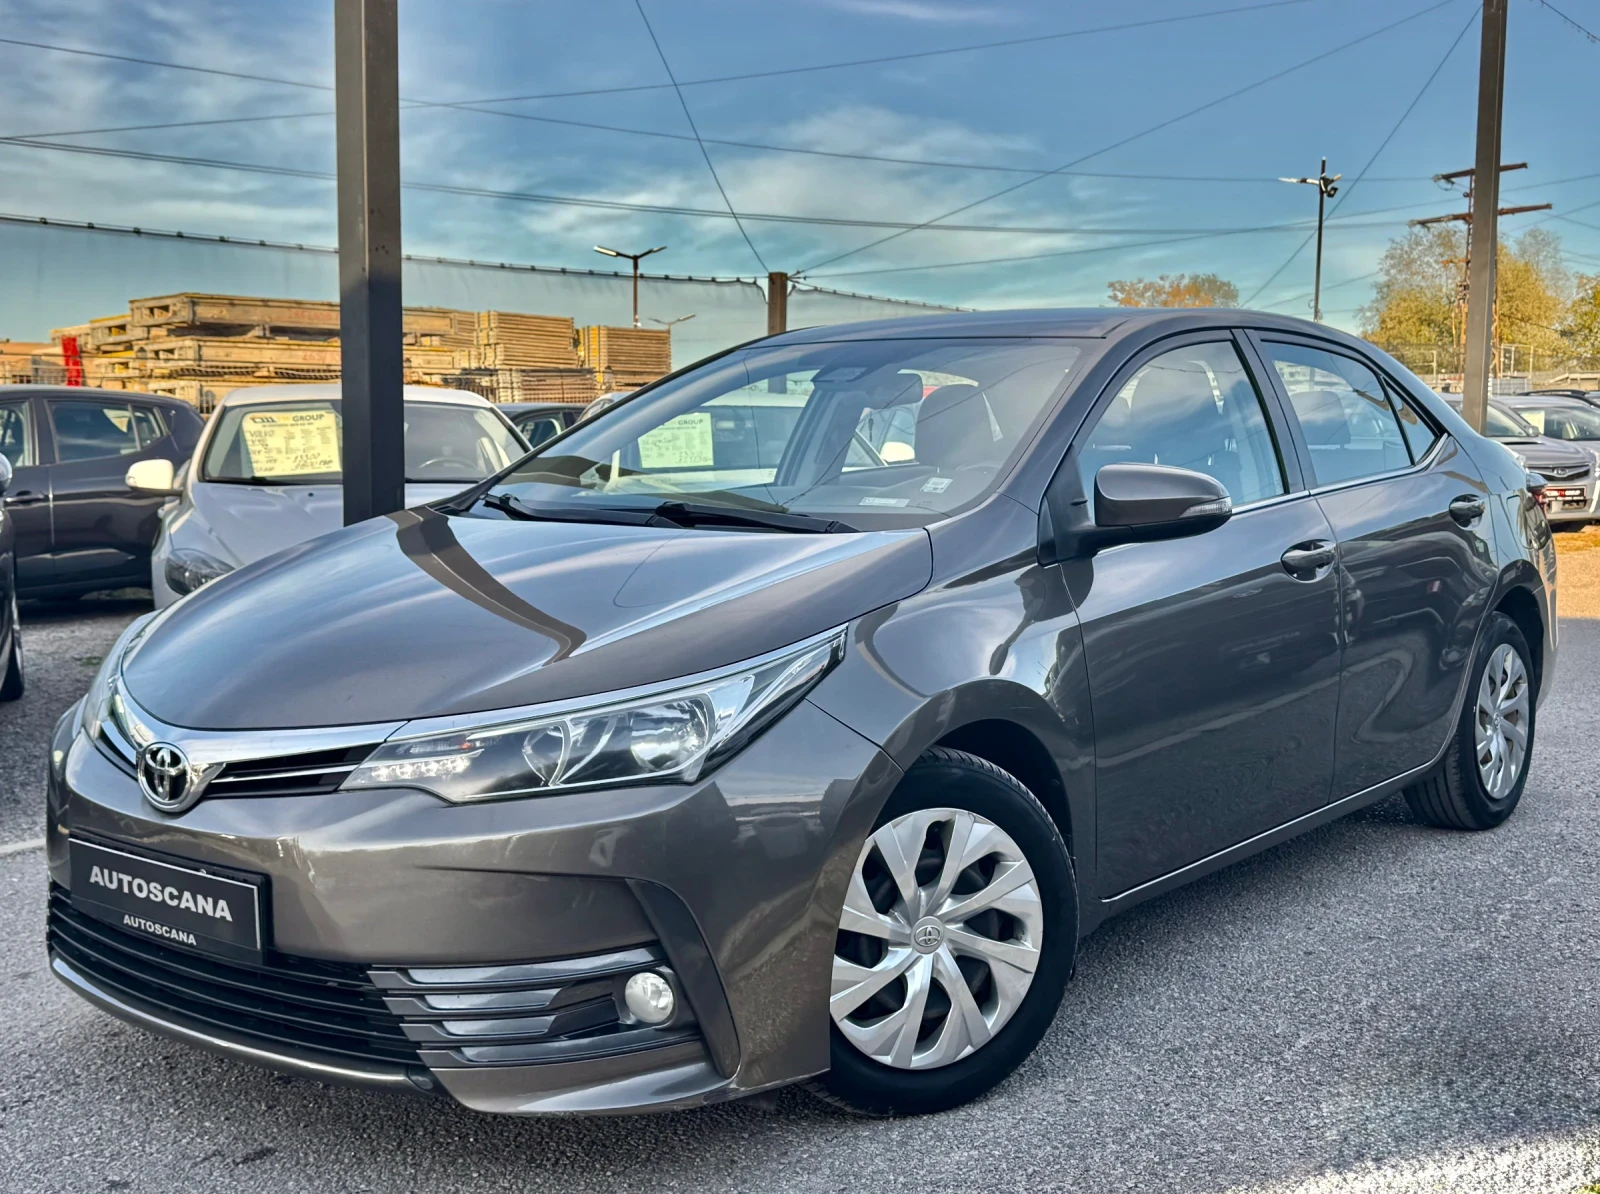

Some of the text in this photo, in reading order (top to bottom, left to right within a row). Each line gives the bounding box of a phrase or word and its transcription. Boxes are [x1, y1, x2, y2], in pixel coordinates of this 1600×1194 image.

[292, 414, 325, 422] GROUP
[677, 418, 703, 426] GROUP
[89, 865, 233, 922] AUTOSCANA
[123, 914, 196, 946] AUTOSCANA
